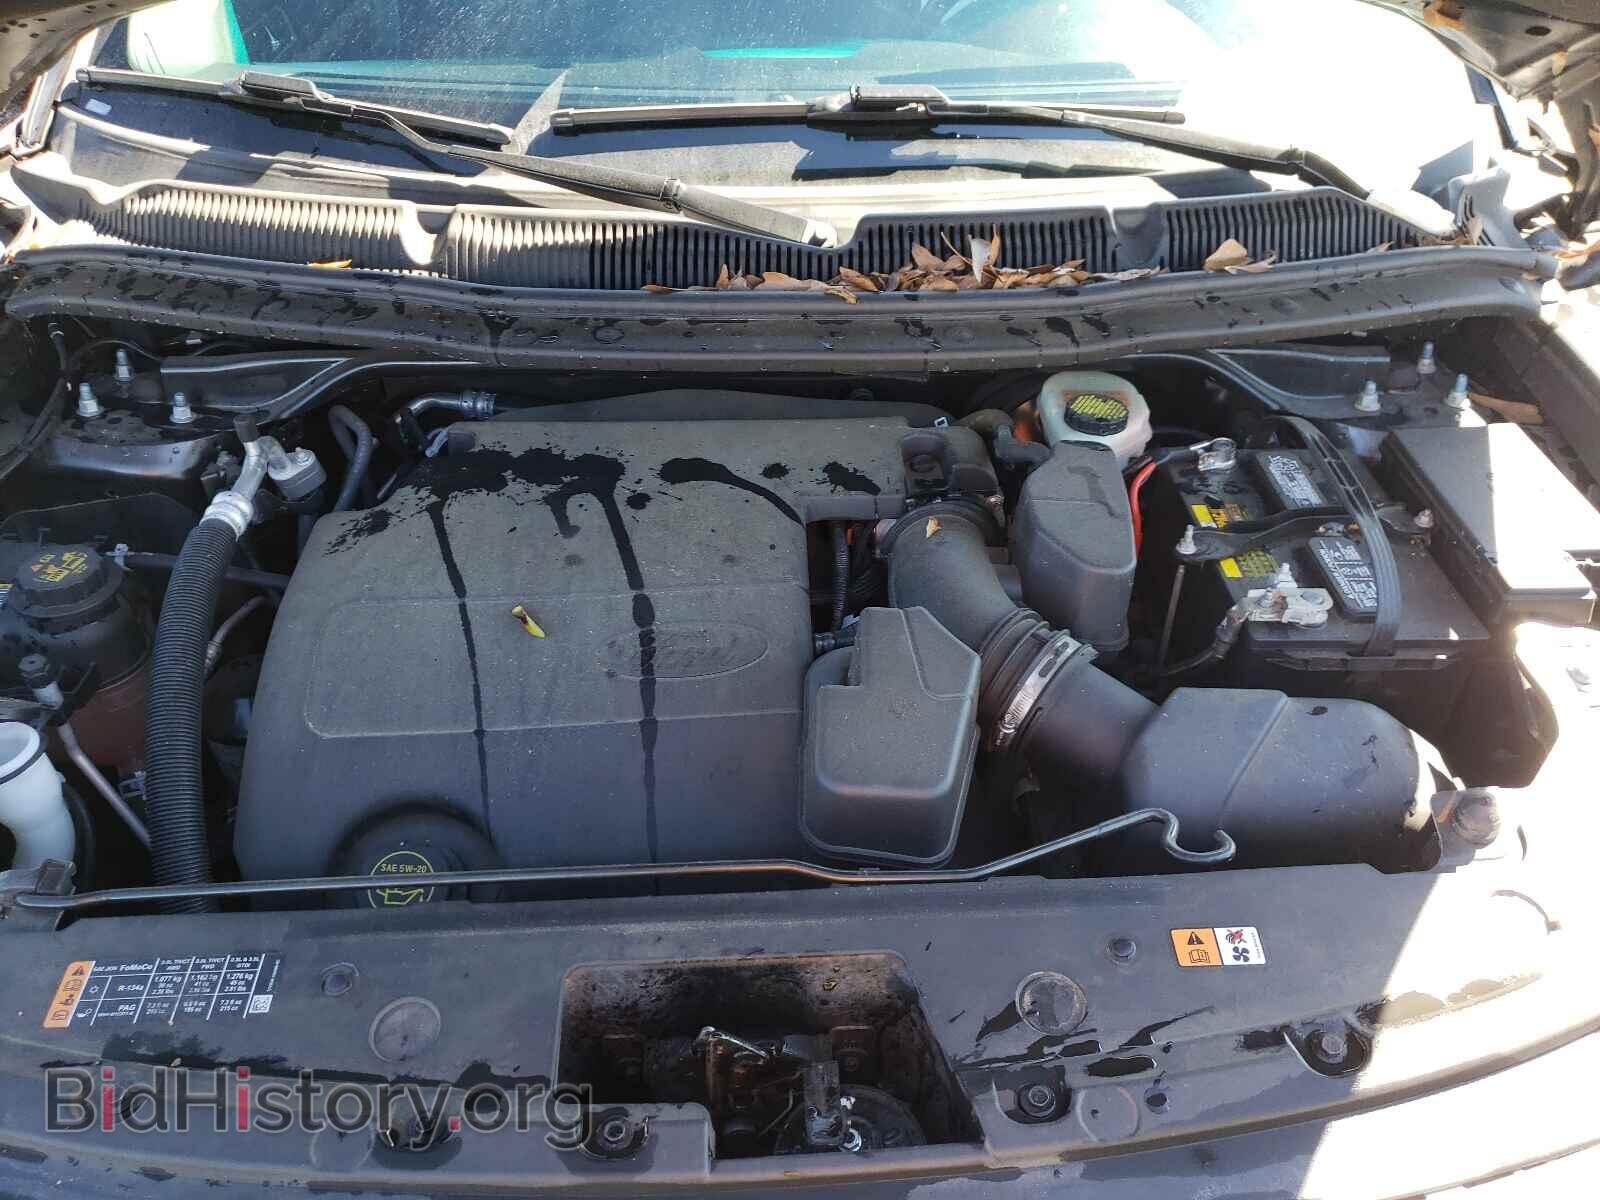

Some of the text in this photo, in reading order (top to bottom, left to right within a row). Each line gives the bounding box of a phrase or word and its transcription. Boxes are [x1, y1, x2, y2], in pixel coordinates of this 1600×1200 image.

[380, 863, 427, 873] SAE 5W-20
[120, 963, 153, 972] FoMoCo
[118, 1004, 136, 1012] PAG
